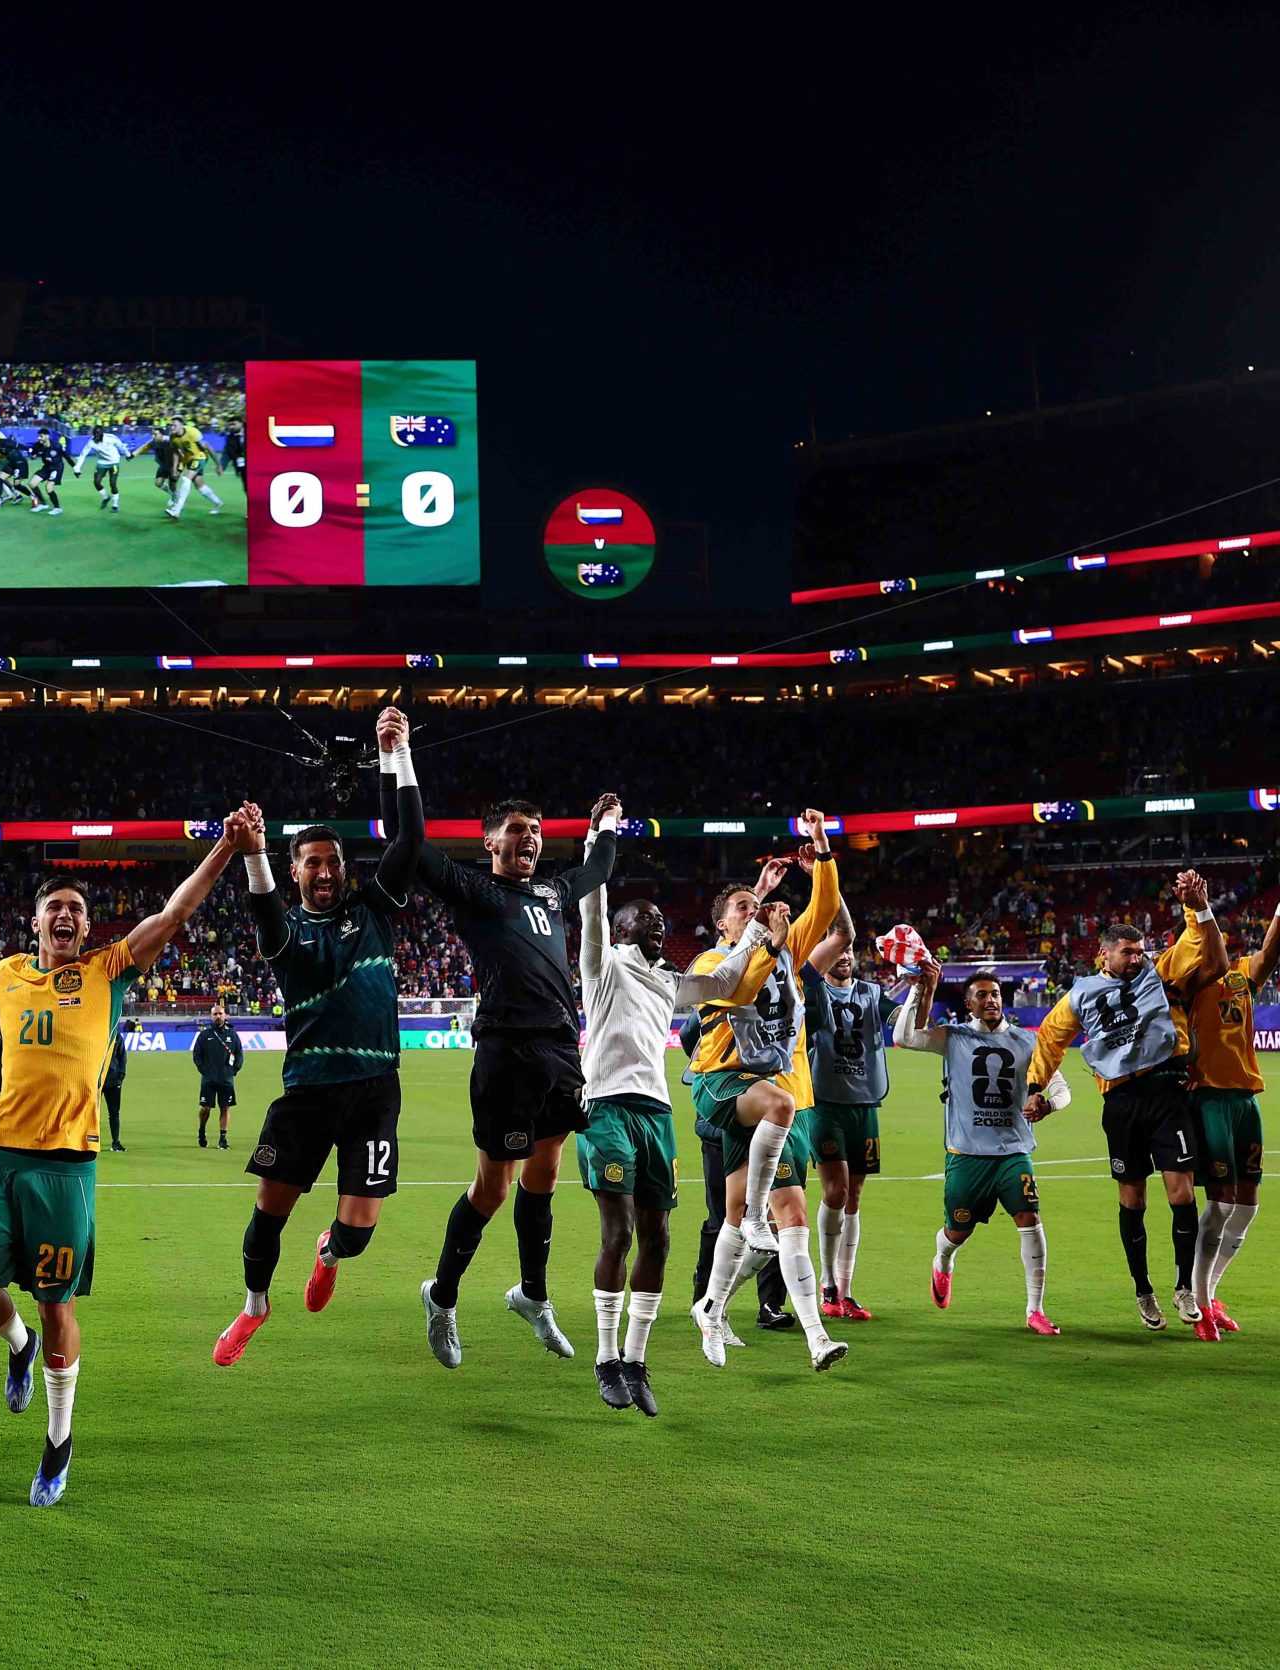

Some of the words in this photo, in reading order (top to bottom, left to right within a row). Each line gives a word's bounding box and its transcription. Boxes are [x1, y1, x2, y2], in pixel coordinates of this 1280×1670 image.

[270, 471, 323, 527] 0
[401, 470, 455, 527] 0
[1145, 798, 1195, 812] AUSTRALIA
[703, 821, 746, 833] AUSTRALIA
[914, 812, 958, 826] PARAGUAY
[71, 825, 113, 836] PARAGUAY
[282, 823, 324, 835] AUSTR
[523, 905, 552, 936] 18
[1109, 1013, 1129, 1026] IFA
[1218, 999, 1244, 1024] 26
[19, 1009, 54, 1046] 20
[778, 1018, 795, 1028] CUP
[121, 1032, 167, 1050] VISA
[1105, 1031, 1144, 1050] 2026
[984, 1096, 1004, 1104] FIFA
[973, 1110, 999, 1118] WORLD
[973, 1118, 1013, 1128] 2026
[865, 1137, 881, 1161] 21
[1176, 1130, 1188, 1154] 1
[366, 1140, 390, 1176] 12
[1246, 1142, 1265, 1170] 2
[35, 1243, 74, 1281] 20
